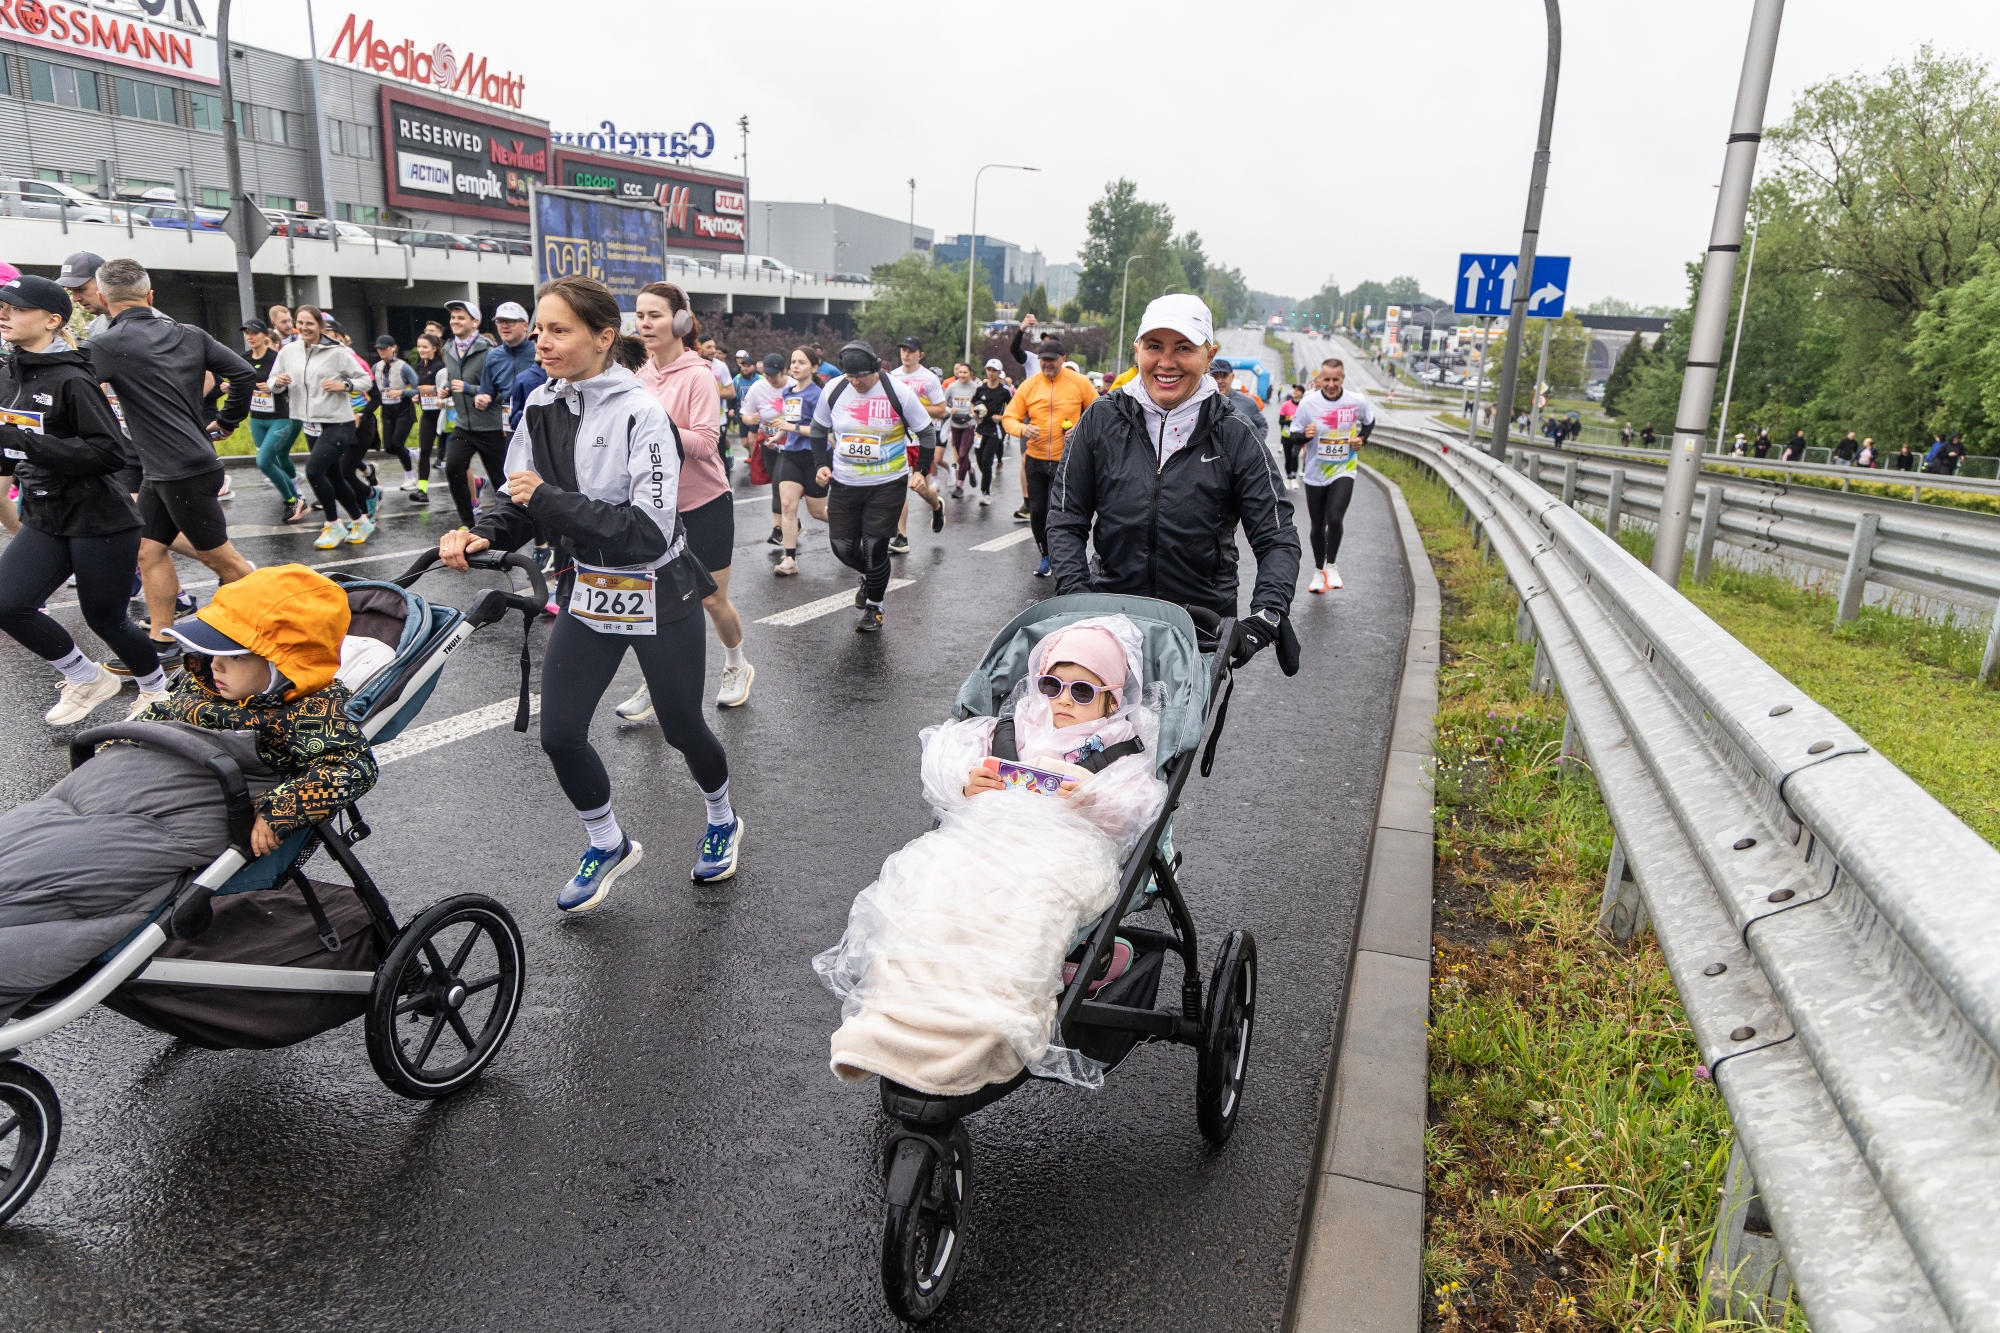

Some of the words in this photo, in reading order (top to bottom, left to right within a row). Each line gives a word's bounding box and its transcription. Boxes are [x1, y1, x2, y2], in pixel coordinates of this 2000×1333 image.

[0, 0, 193, 68] ROSSMANN
[328, 13, 433, 84] Media
[450, 52, 526, 109] Markt
[399, 118, 482, 153] RESERVED
[409, 162, 450, 185] ACTION
[455, 169, 503, 200] empik
[575, 172, 617, 189] CROPP
[716, 194, 744, 211] JULA
[868, 398, 891, 419] FIAT
[848, 443, 871, 456] 848
[1325, 445, 1343, 453] 864
[586, 587, 645, 615] 1262
[442, 634, 463, 655] THULE
